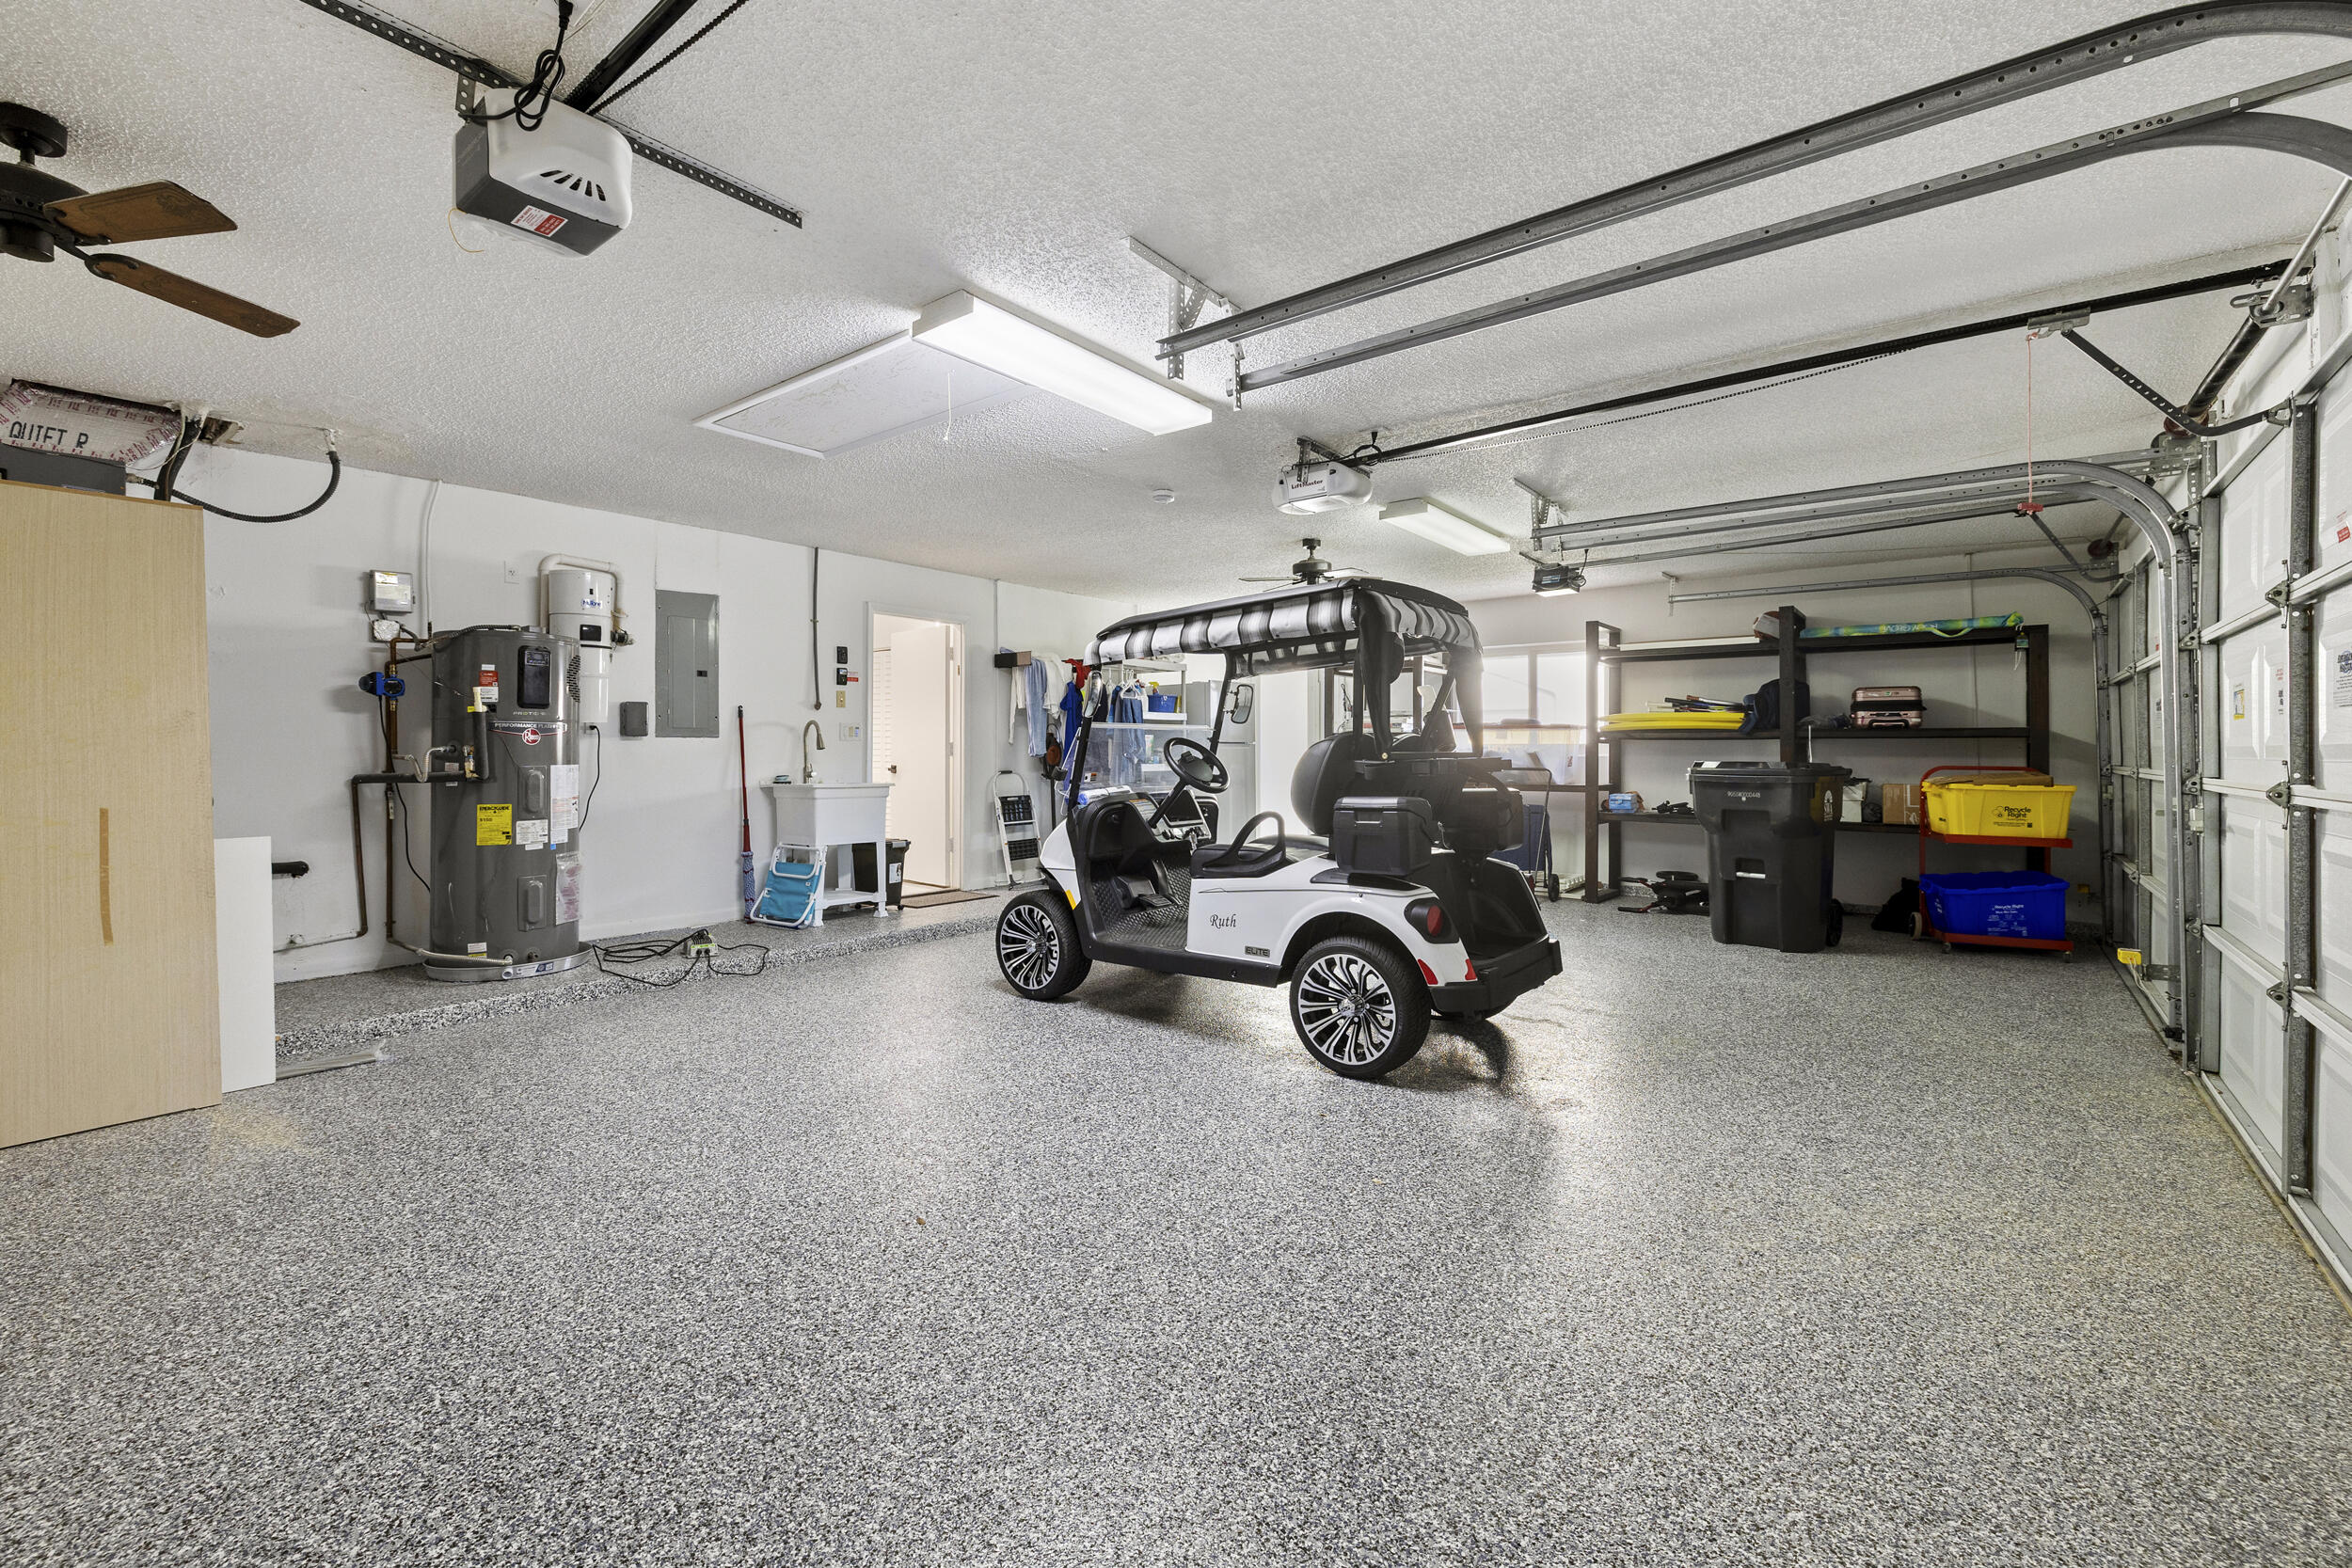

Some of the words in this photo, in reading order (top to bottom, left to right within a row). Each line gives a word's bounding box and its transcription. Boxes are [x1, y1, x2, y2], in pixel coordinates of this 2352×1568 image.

[1291, 480, 1324, 490] LiftMaster
[1210, 913, 1237, 929] Ruth
[1246, 946, 1269, 957] ELITE
